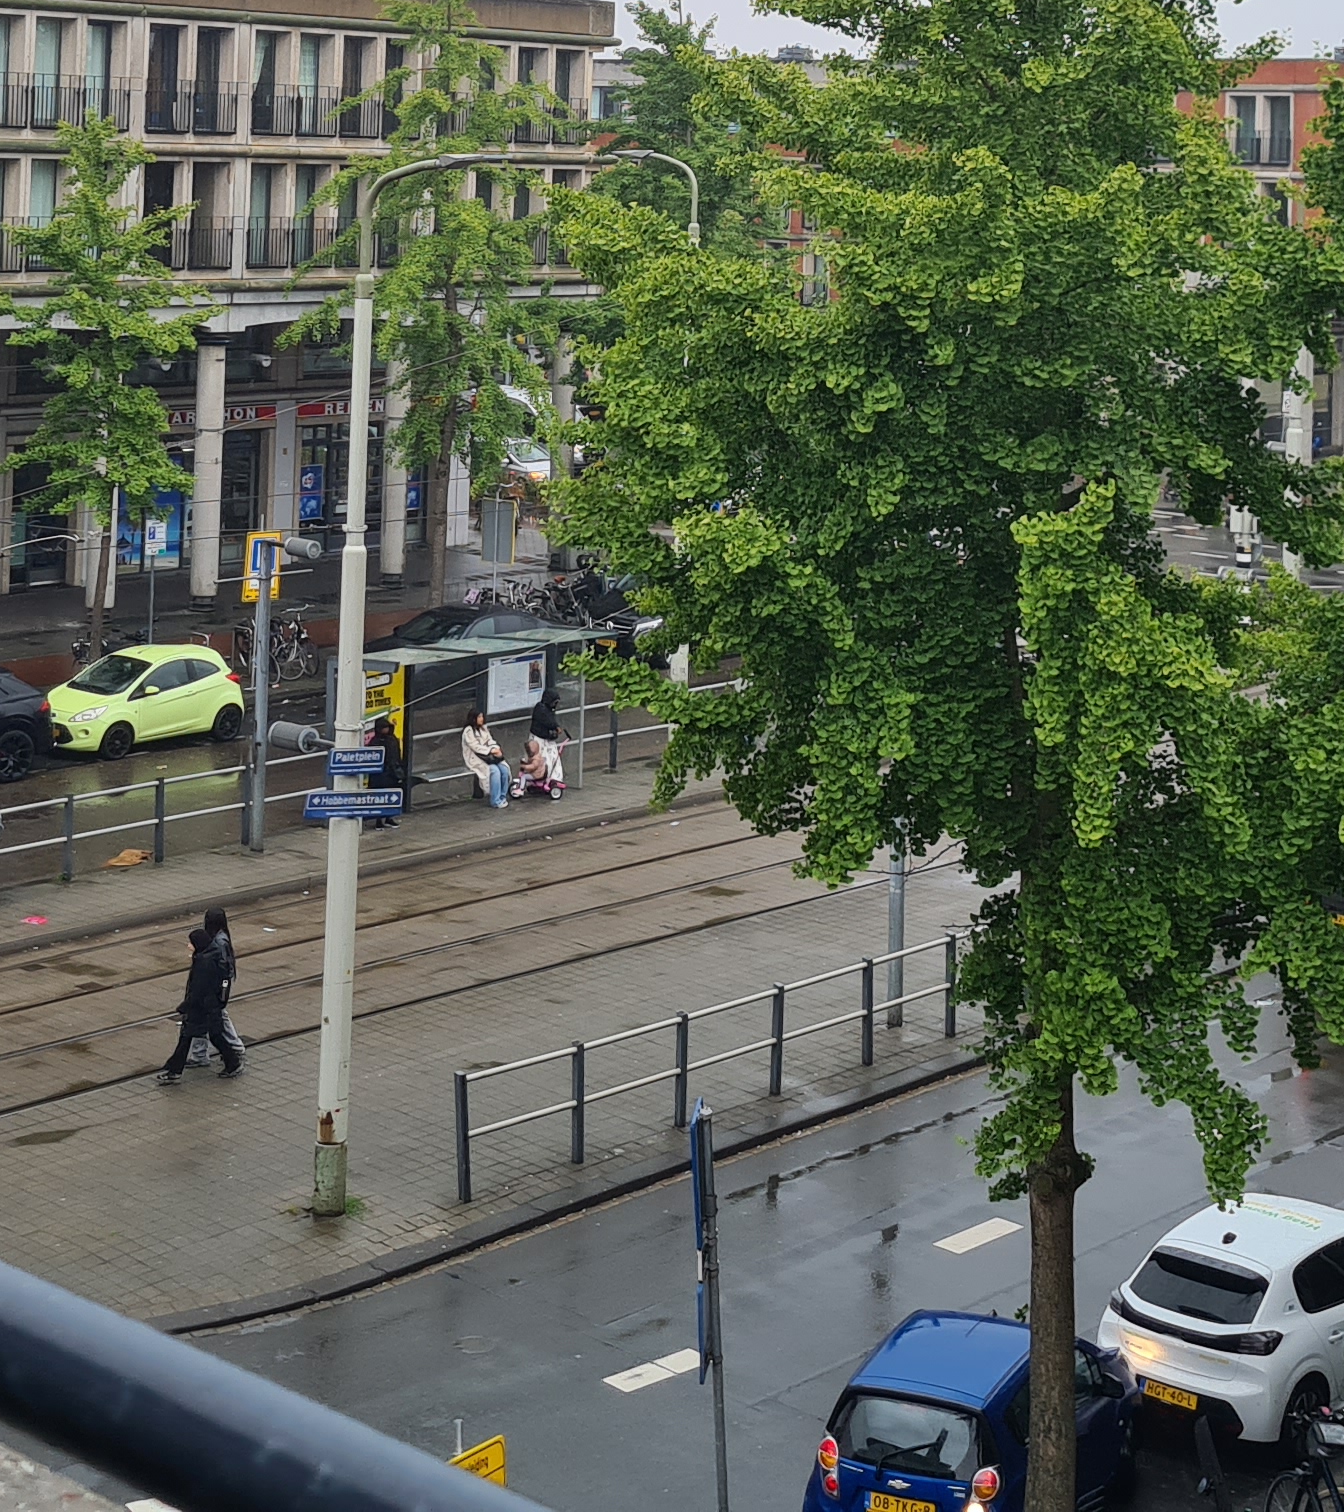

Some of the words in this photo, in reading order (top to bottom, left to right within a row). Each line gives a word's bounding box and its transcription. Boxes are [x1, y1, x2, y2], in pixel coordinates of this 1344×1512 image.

[325, 399, 384, 415] REIEN
[335, 751, 380, 763] Paletplein
[321, 794, 389, 806] Hobbemastraat
[1146, 1380, 1194, 1407] HGT-40-L
